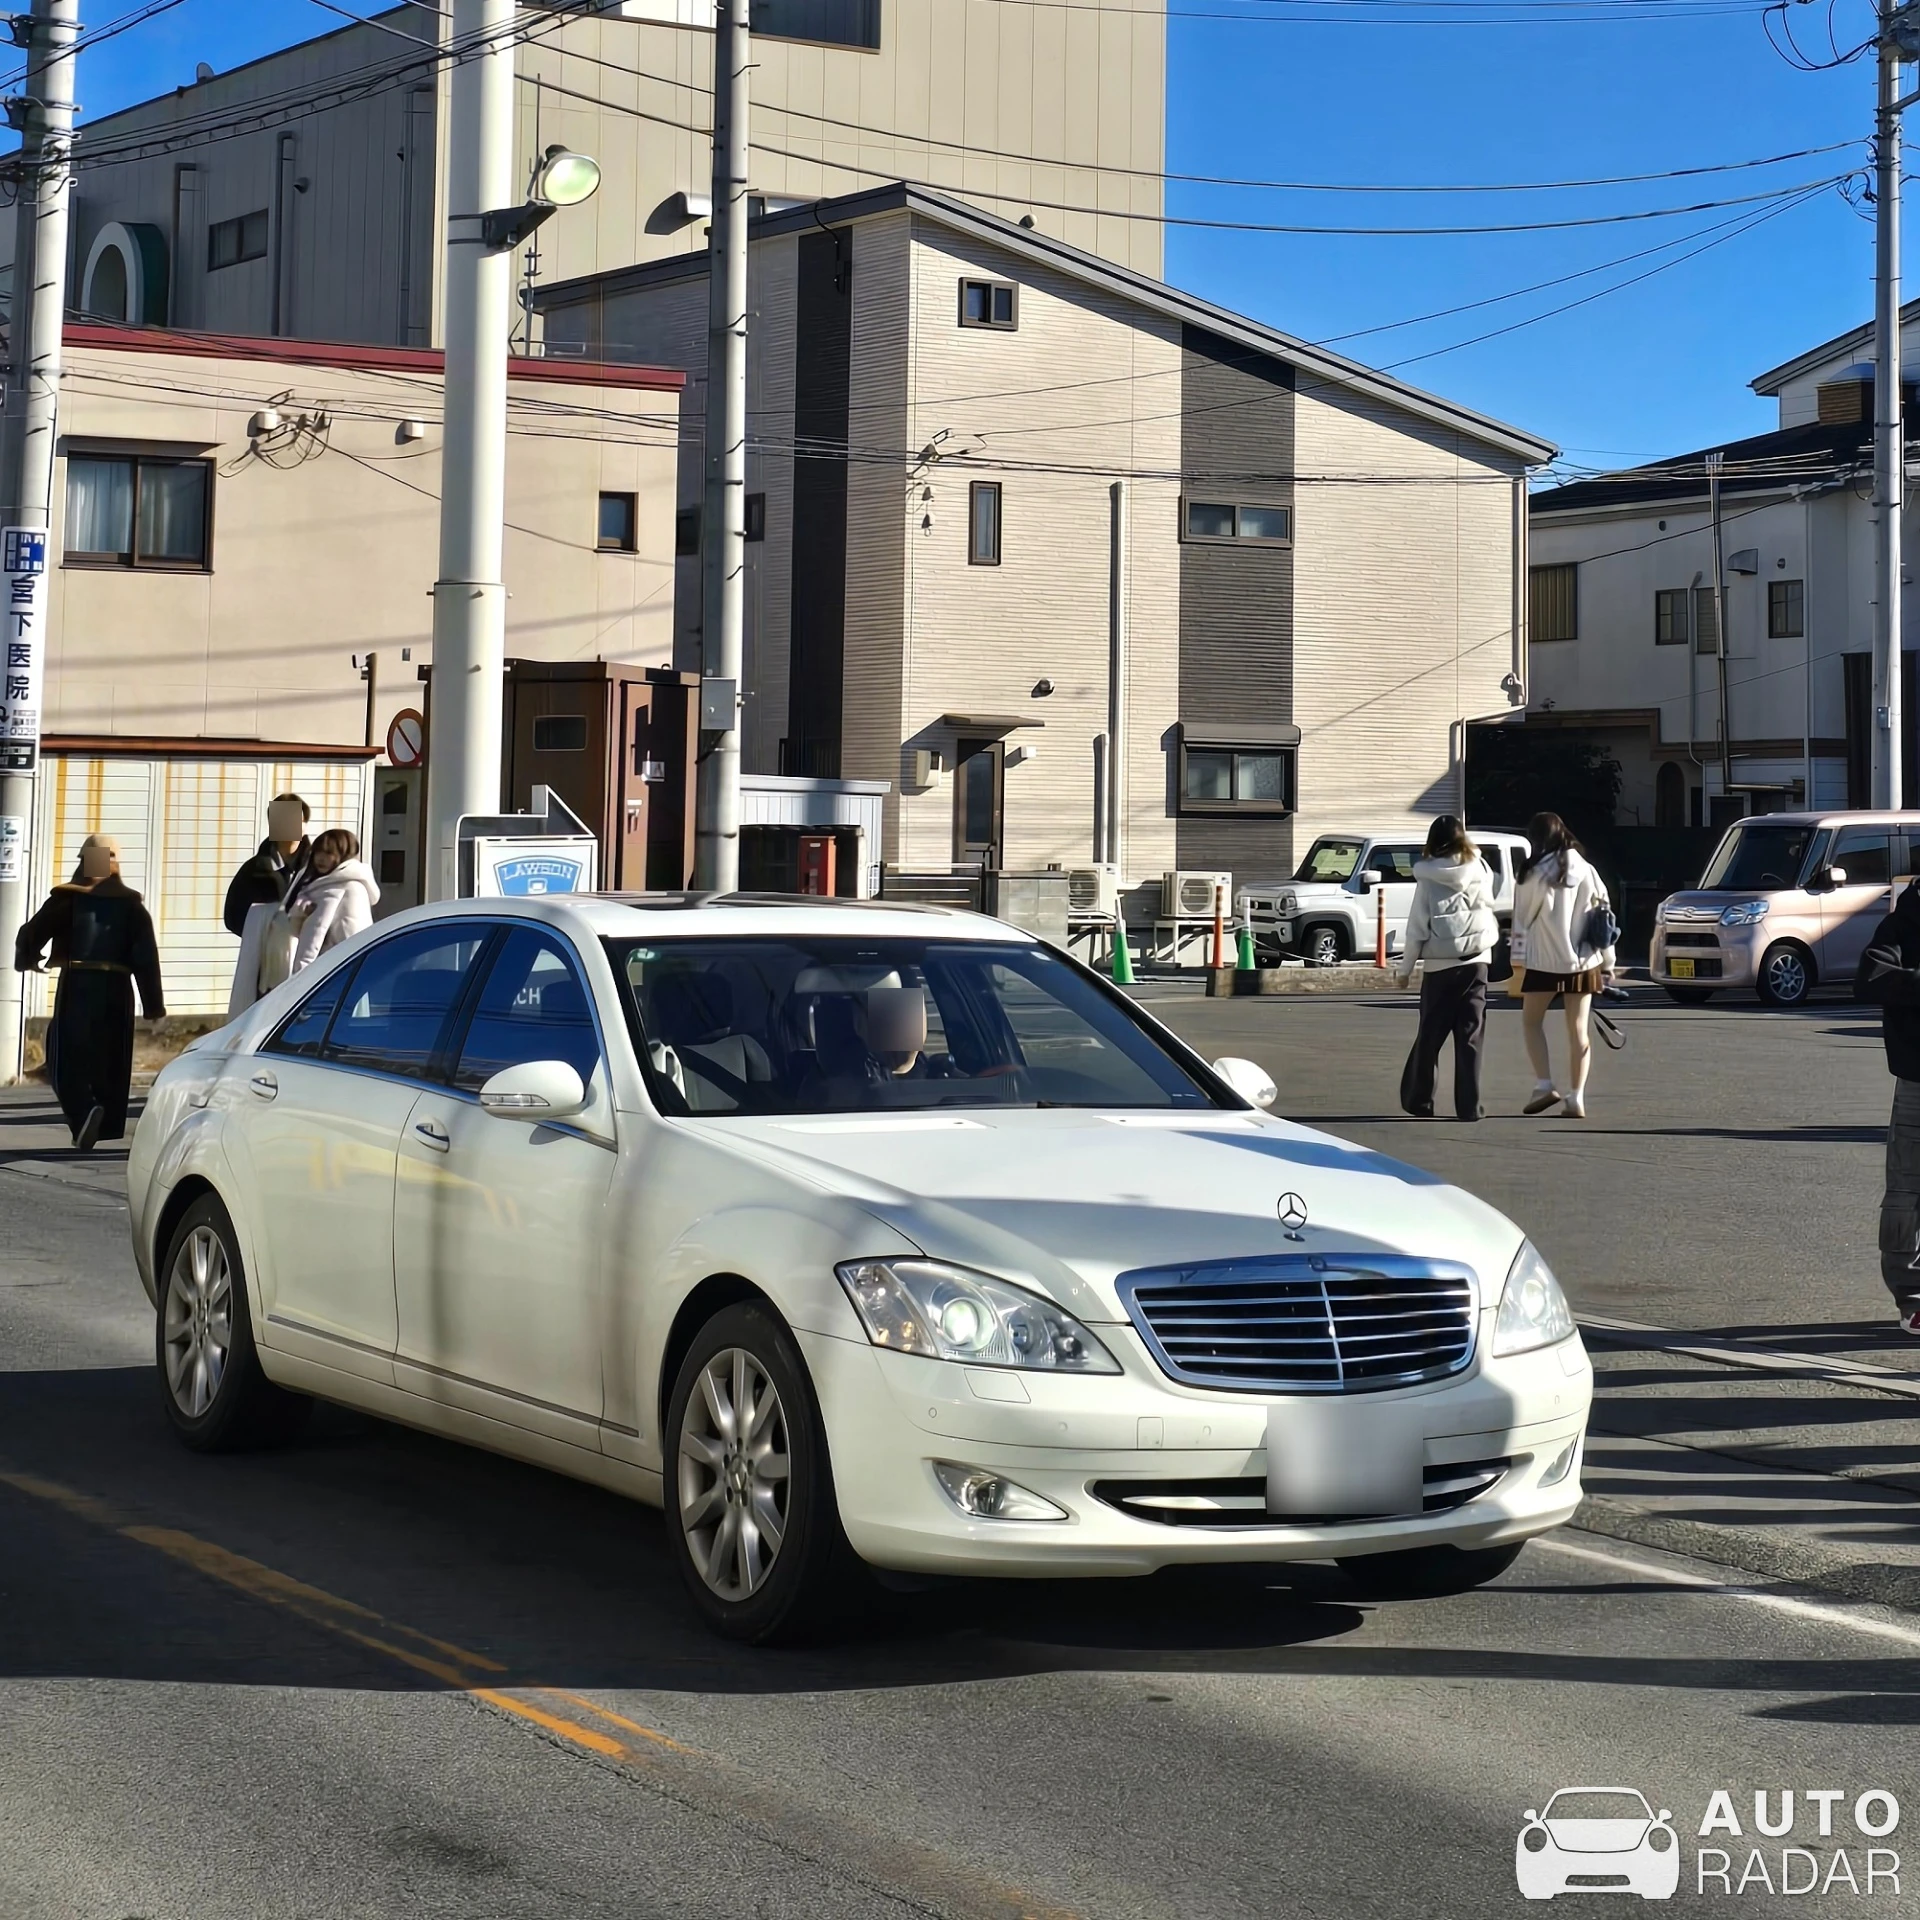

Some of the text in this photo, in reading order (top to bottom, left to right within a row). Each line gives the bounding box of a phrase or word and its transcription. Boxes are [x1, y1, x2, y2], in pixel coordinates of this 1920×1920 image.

[5, 573, 38, 700] 宮下医院
[502, 862, 574, 880] LAWSON
[512, 987, 541, 1006] CH
